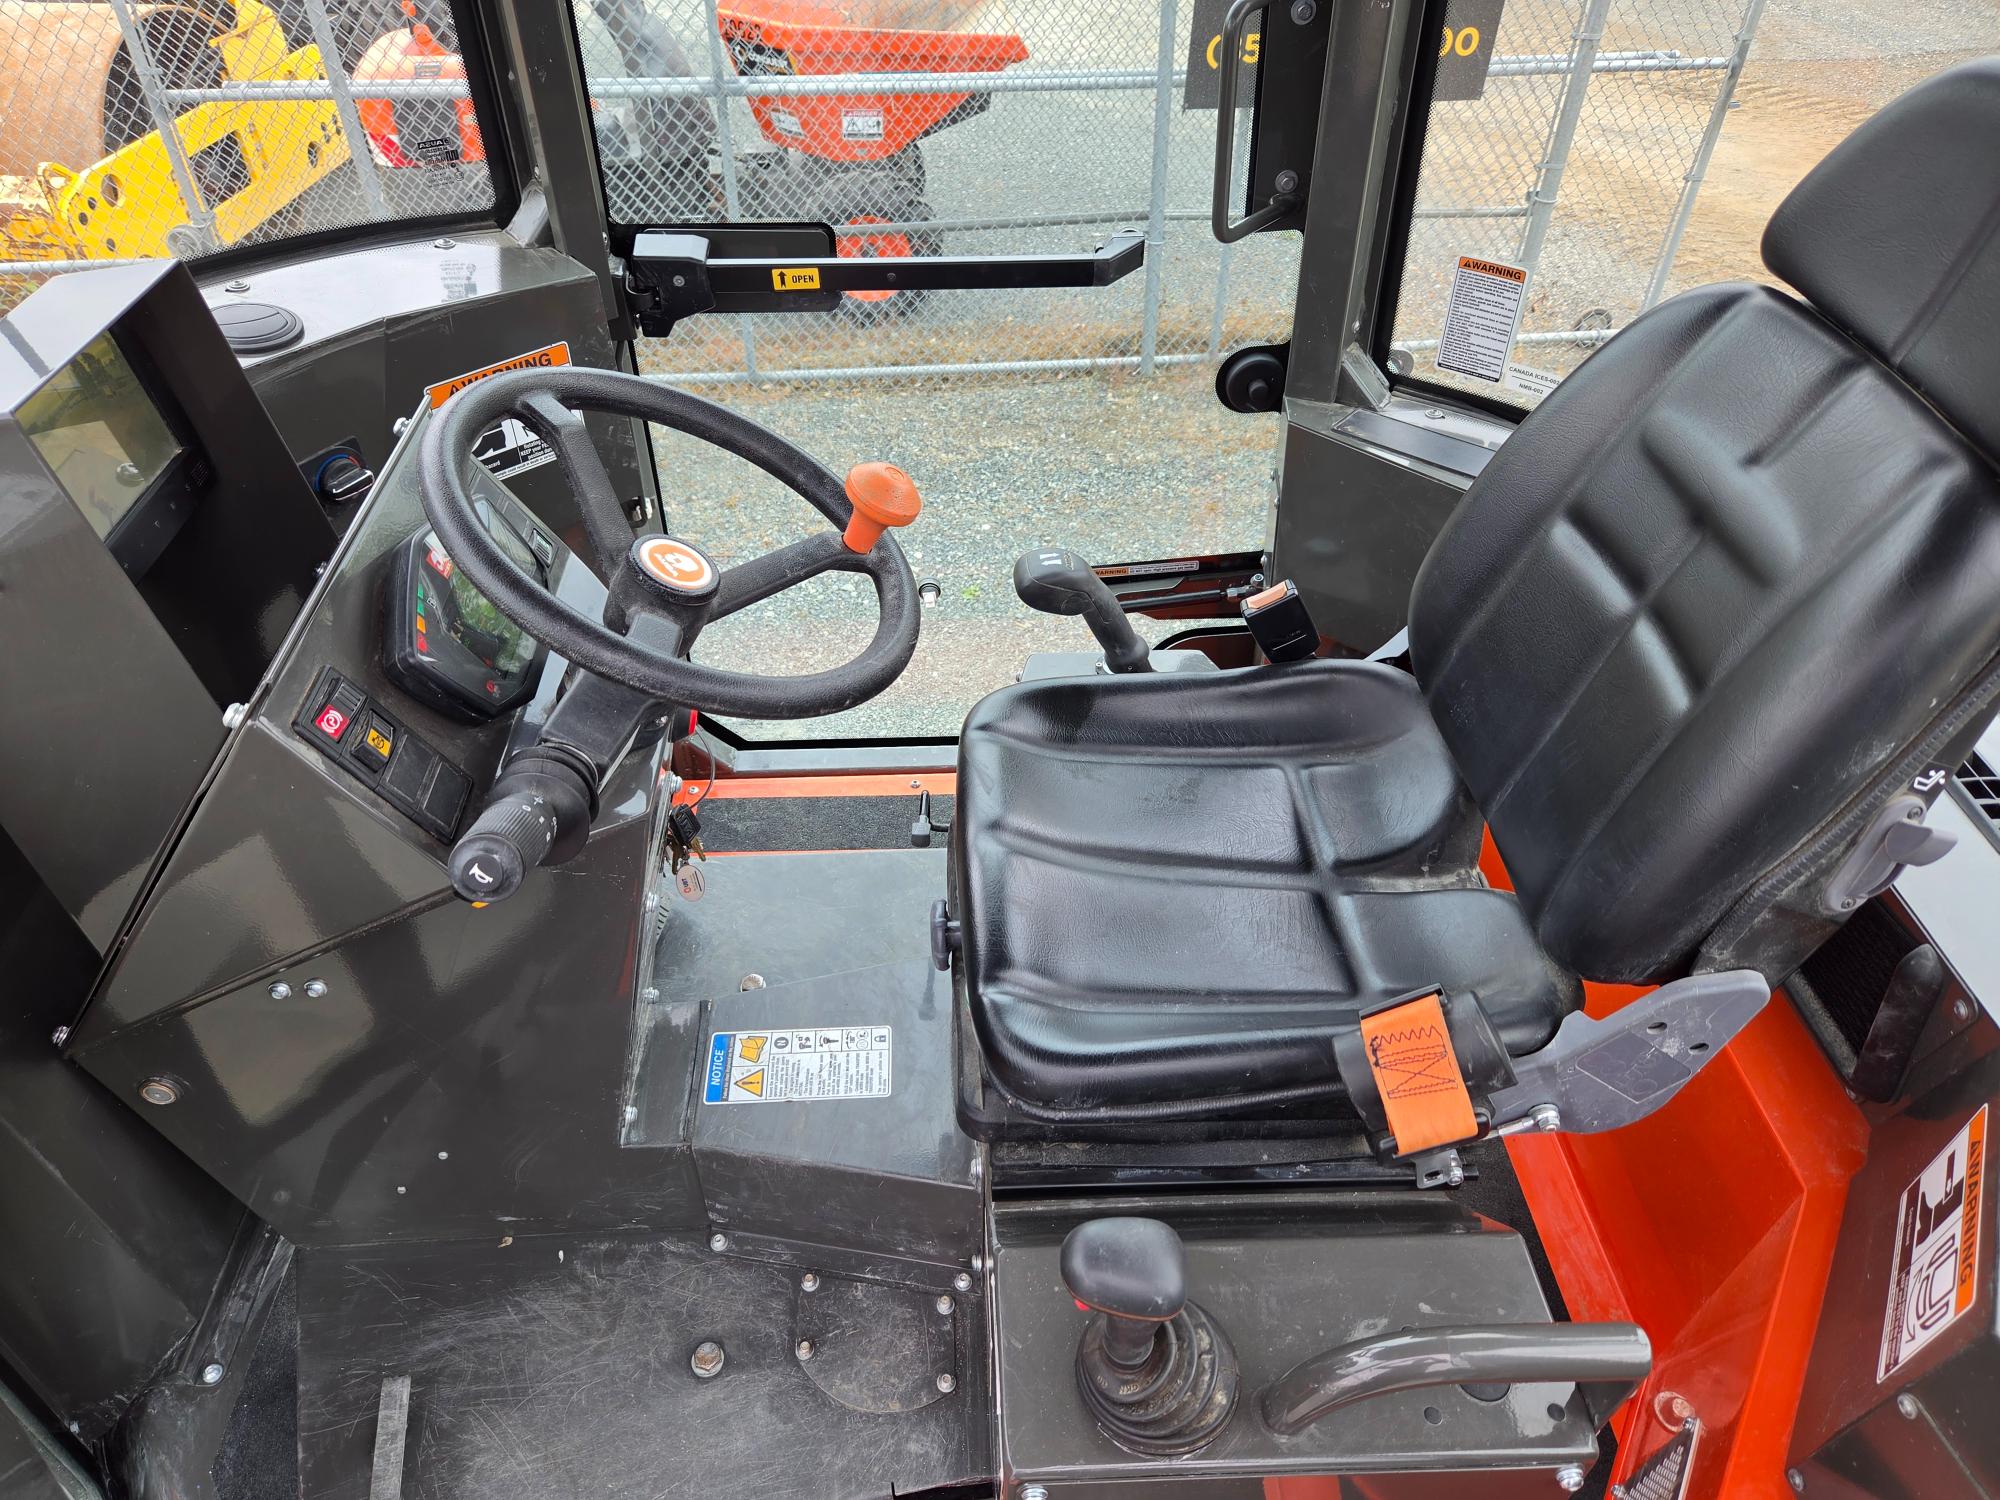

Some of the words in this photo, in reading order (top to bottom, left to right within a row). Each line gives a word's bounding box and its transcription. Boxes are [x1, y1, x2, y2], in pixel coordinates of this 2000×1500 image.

[791, 274, 814, 283] OPEN
[1471, 260, 1522, 281] WARNING
[1509, 366, 1534, 378] CANADA
[710, 1049, 724, 1086] NOTICE
[1960, 1149, 1982, 1287] WARNING
